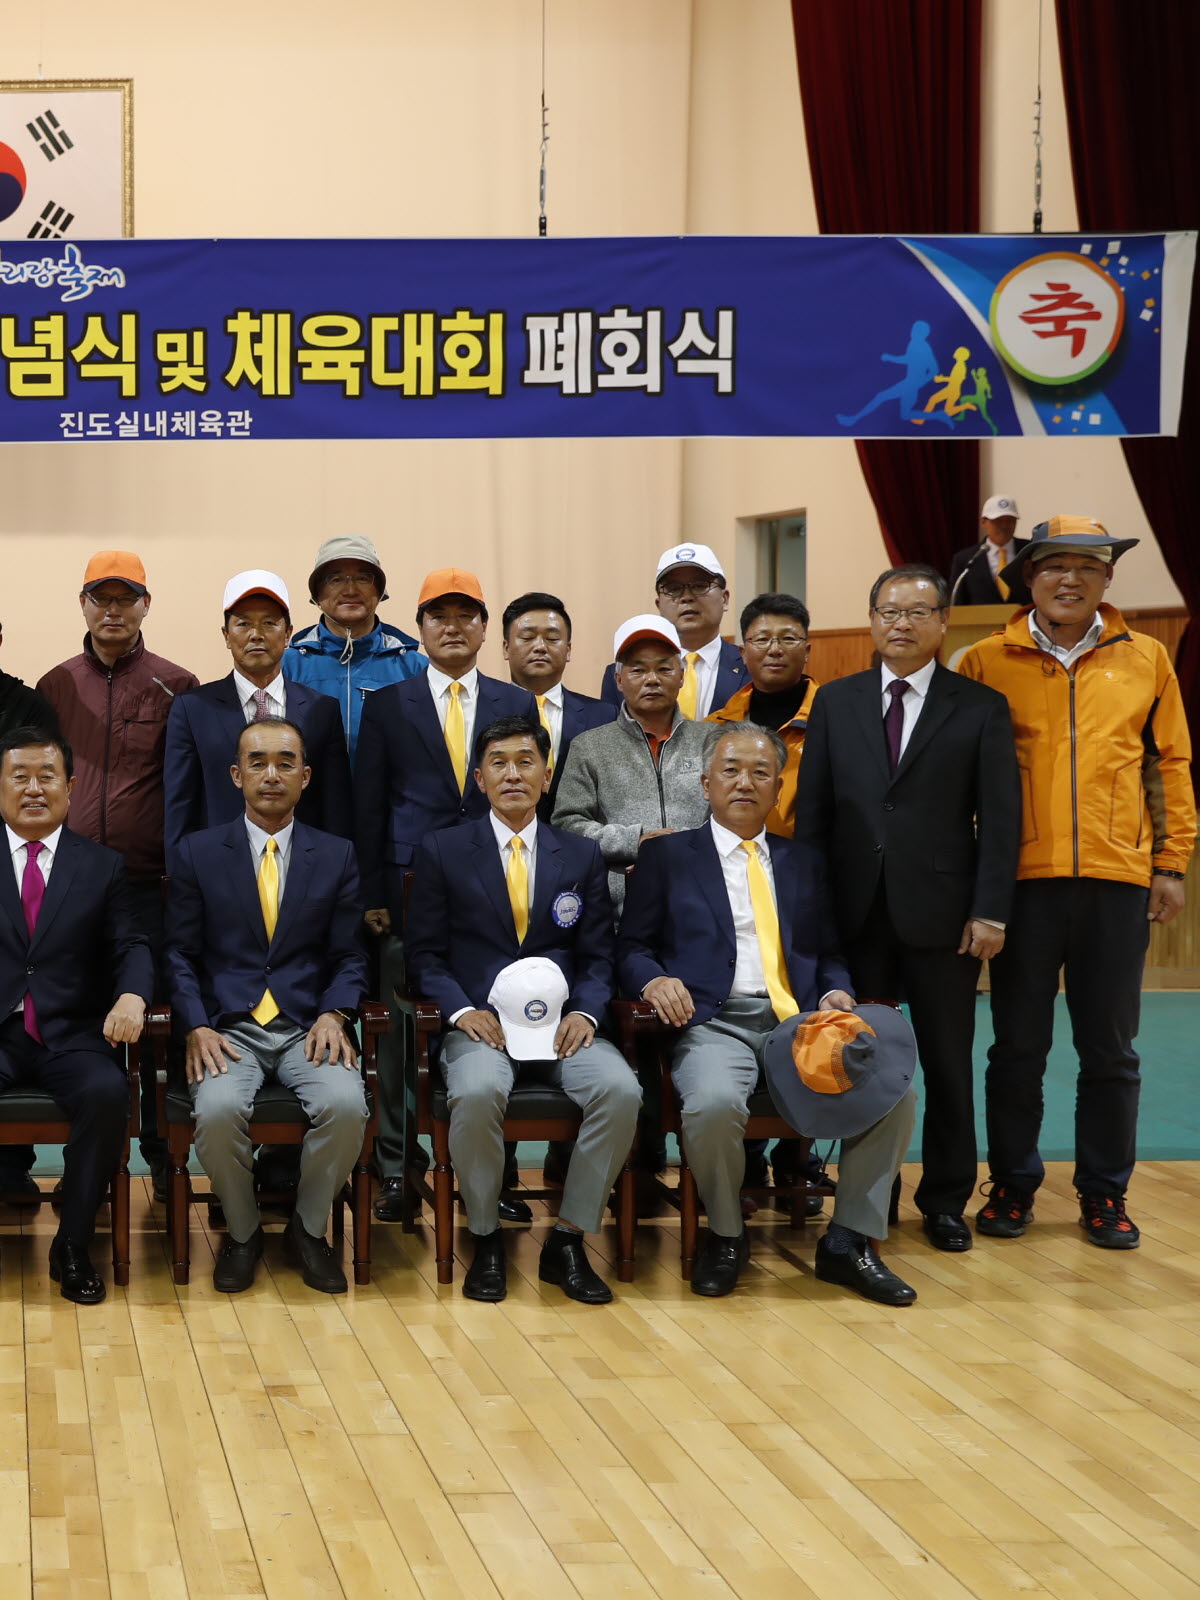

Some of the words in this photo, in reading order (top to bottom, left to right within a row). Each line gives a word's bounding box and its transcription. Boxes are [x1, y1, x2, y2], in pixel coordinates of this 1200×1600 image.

[58, 244, 126, 301] 축제
[156, 331, 206, 392] 및
[225, 310, 504, 396] 체육대회
[523, 308, 733, 394] 폐회식
[1017, 281, 1103, 358] 축
[59, 409, 253, 438] 진도실내체육관
